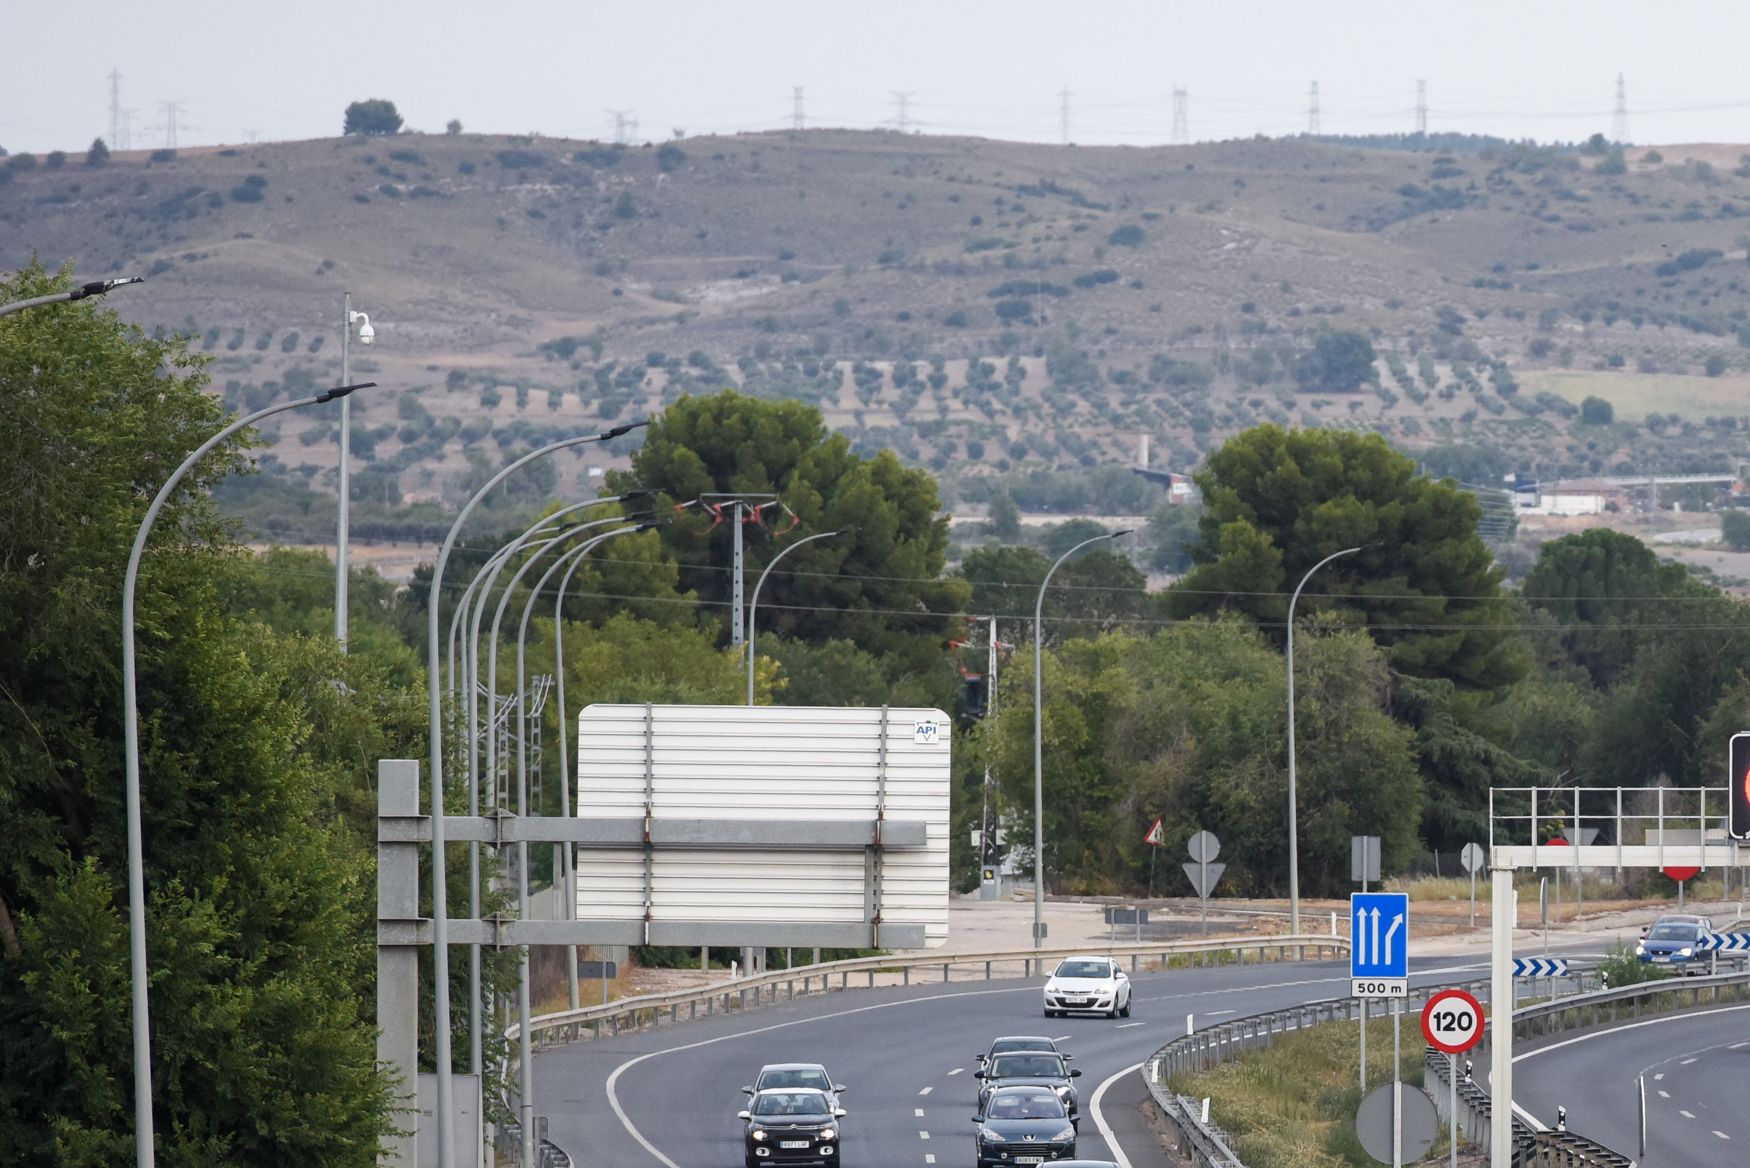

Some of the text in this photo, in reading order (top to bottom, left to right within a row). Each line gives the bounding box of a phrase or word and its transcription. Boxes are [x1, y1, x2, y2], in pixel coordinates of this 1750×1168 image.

[916, 726, 936, 734] API
[1357, 983, 1402, 994] 500 m
[1433, 1011, 1473, 1032] 120
